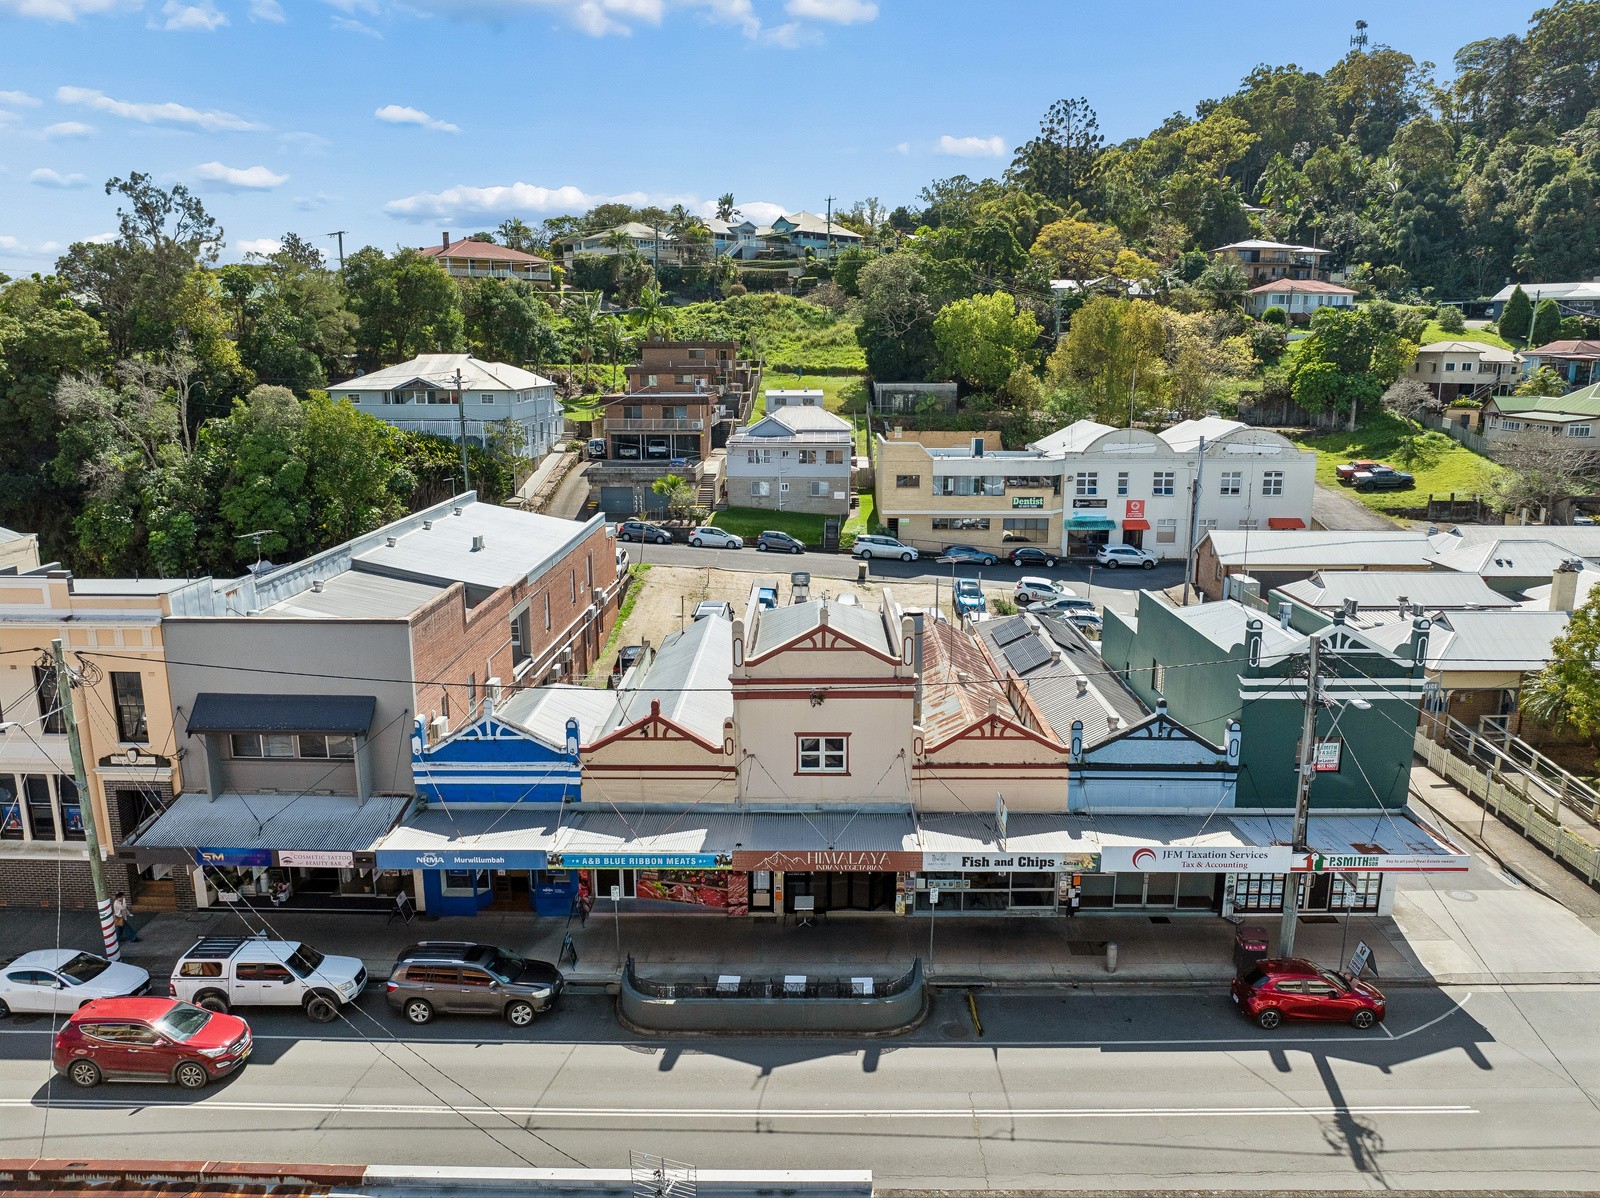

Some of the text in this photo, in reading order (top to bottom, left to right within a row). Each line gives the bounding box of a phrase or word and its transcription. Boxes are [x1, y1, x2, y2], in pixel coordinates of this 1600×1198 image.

[202, 853, 224, 861] SM
[807, 852, 891, 864] HIMALAYA
[1162, 851, 1268, 860] JFM Taxation Services
[962, 856, 1055, 869] Fish and Chips
[1205, 861, 1248, 869] Accounting
[1329, 856, 1369, 866] P.SMITH
